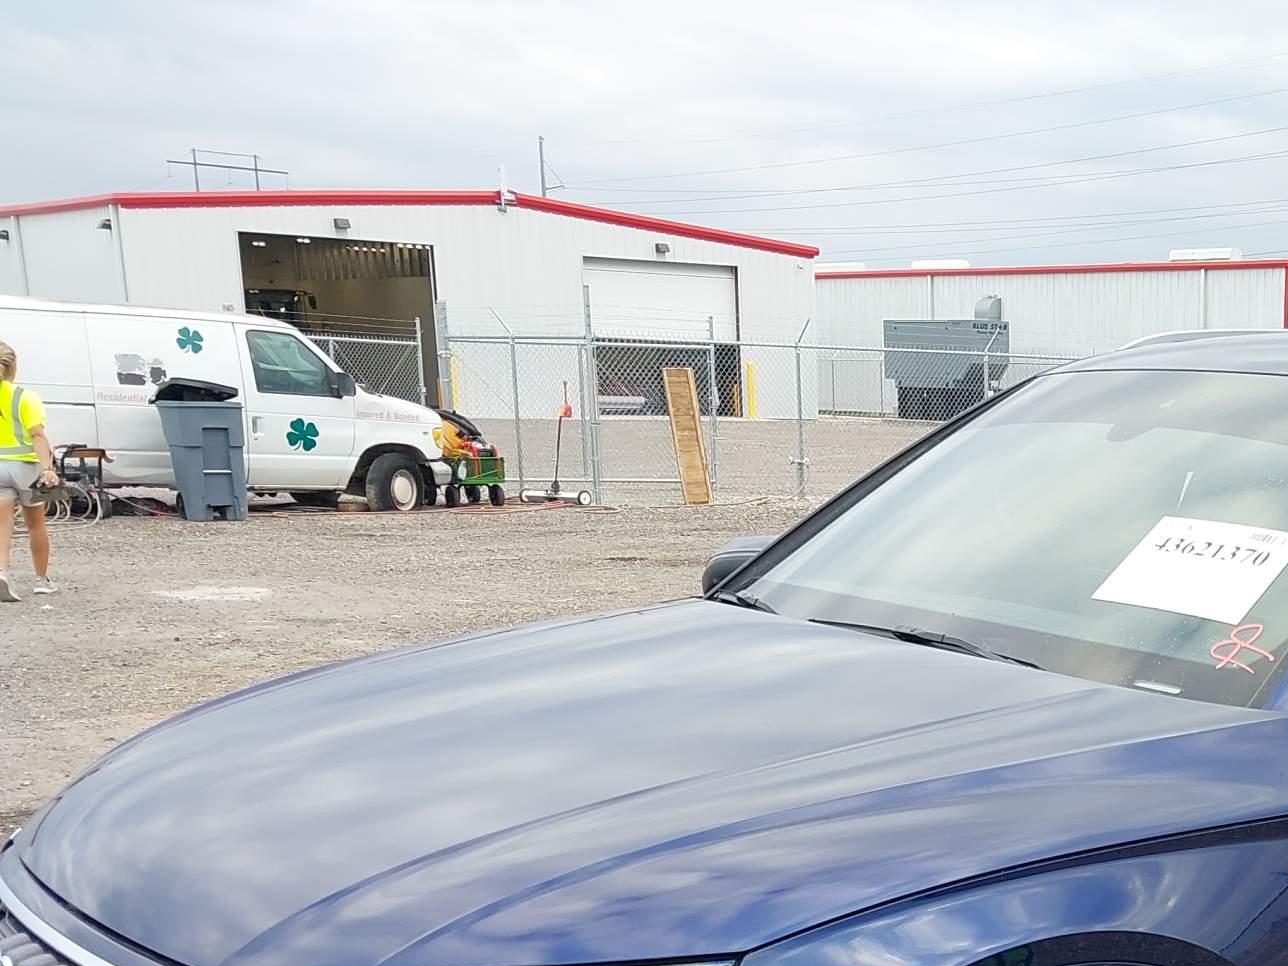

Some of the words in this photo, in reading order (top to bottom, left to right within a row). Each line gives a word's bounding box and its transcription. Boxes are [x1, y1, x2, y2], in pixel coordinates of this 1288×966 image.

[973, 322, 988, 330] BLUE
[96, 391, 147, 403] Residential
[1155, 536, 1271, 567] 43621370
